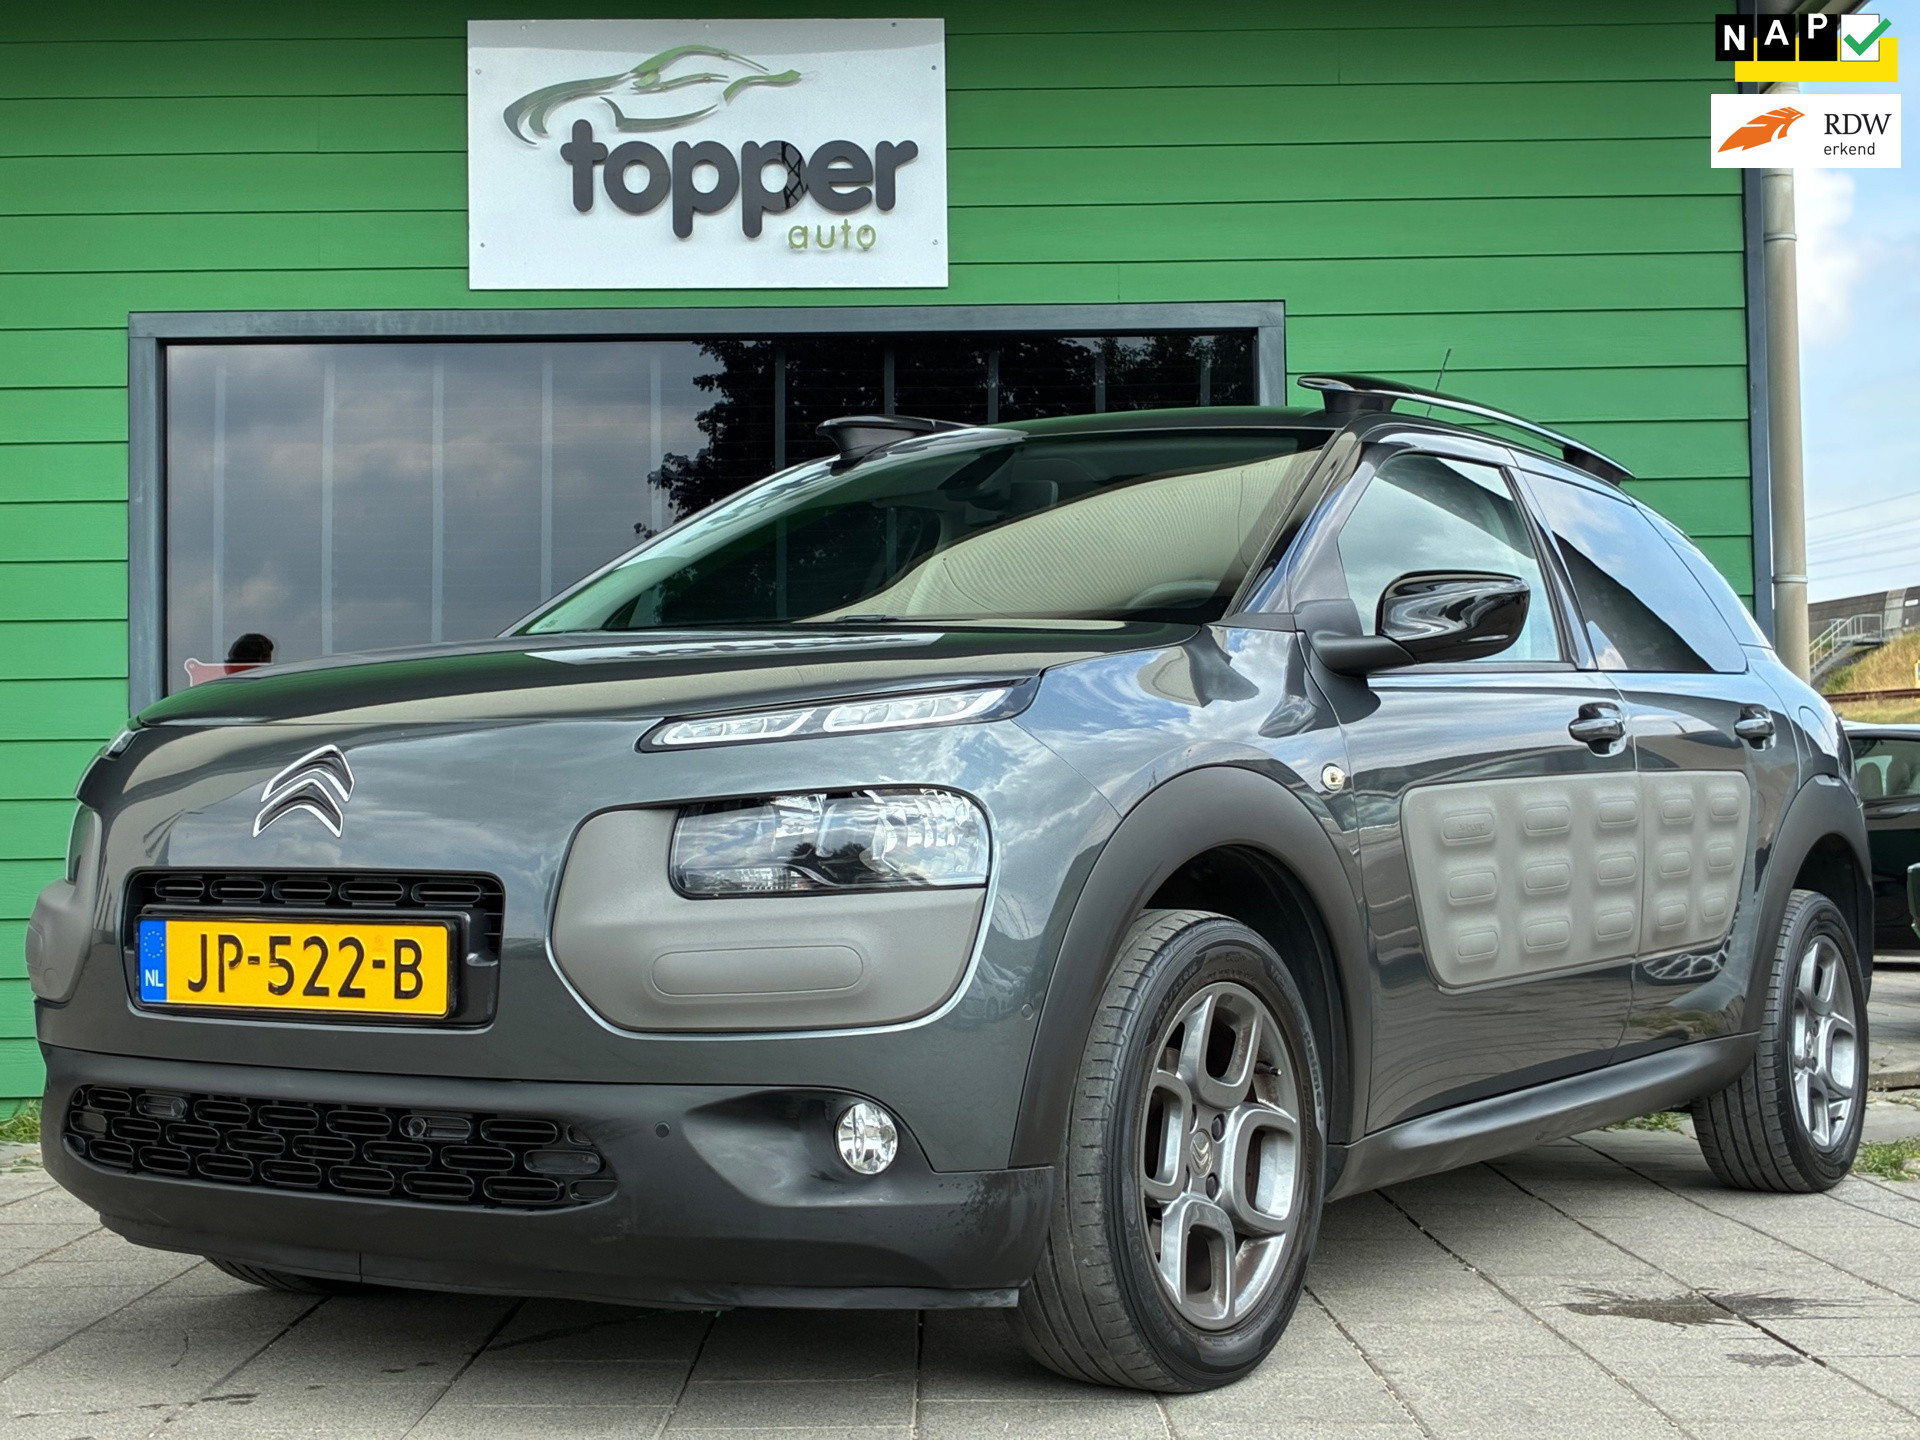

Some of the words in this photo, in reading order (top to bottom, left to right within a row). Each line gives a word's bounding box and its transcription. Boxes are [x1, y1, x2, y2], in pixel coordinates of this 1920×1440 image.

[560, 119, 919, 239] topper
[788, 218, 877, 250] auto
[144, 969, 164, 987] NL
[187, 933, 424, 1001] JP-522-B
